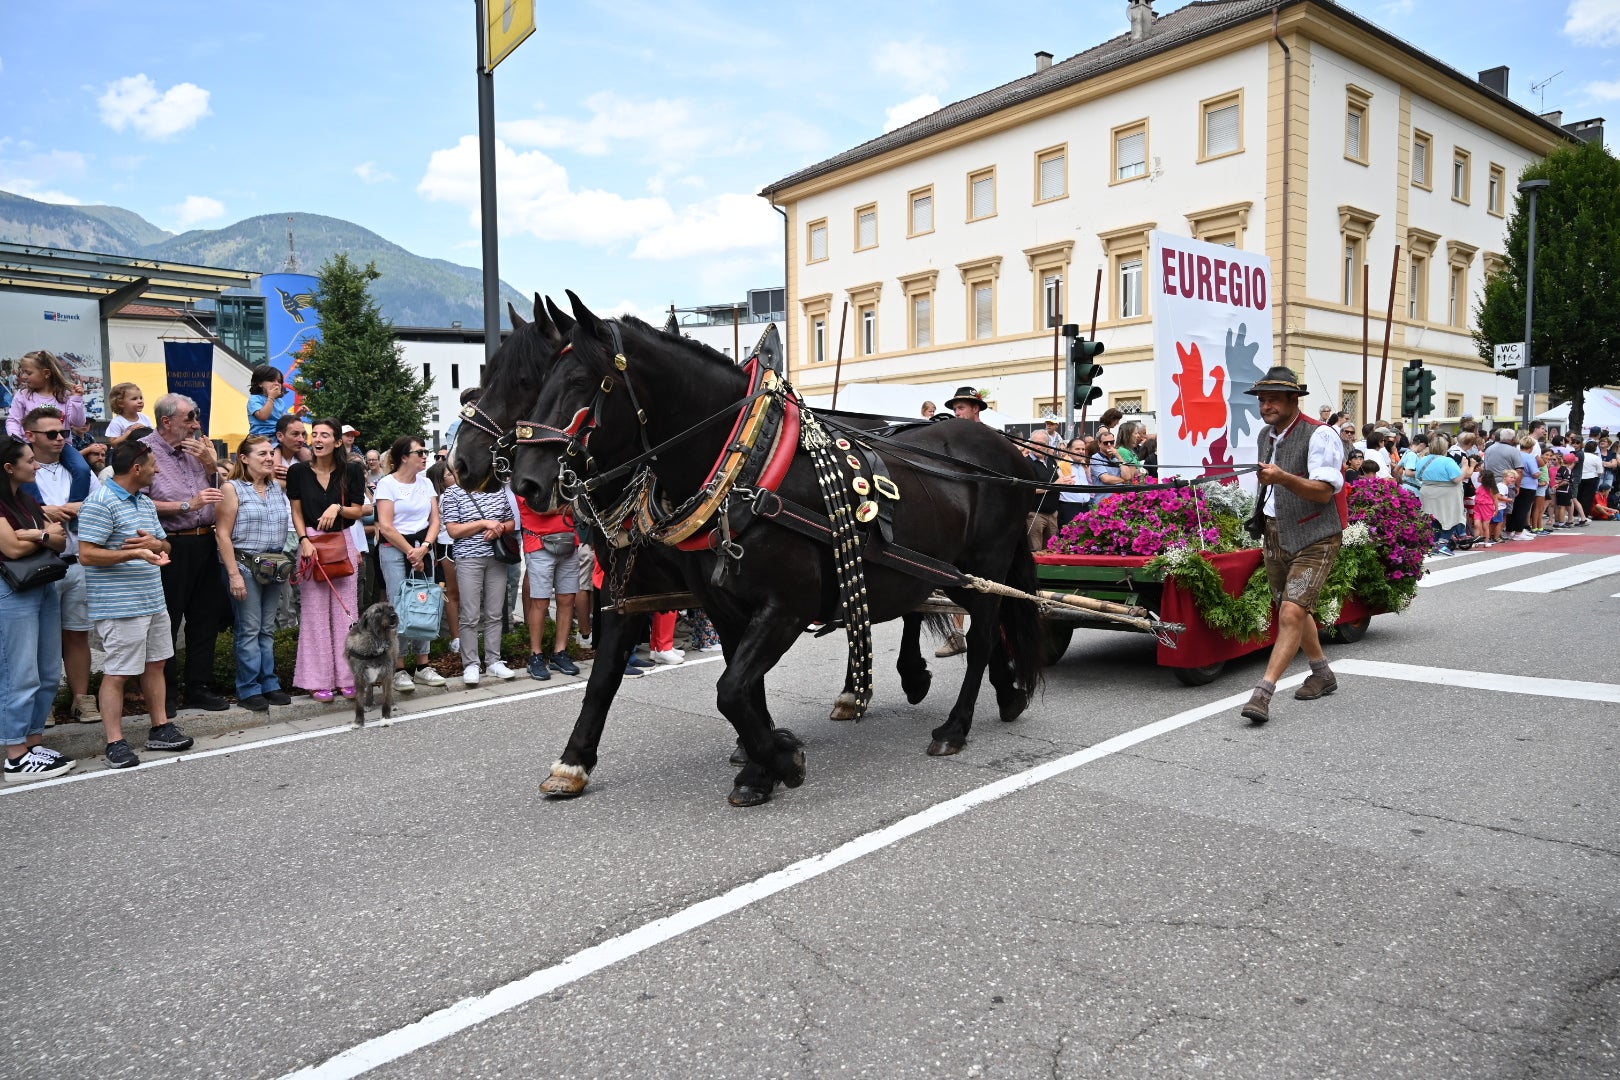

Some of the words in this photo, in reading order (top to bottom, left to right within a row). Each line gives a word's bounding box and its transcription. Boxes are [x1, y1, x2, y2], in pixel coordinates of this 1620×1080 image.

[1161, 247, 1267, 311] EUREGIO
[57, 312, 80, 320] Bruneck
[1500, 344, 1518, 353] WC
